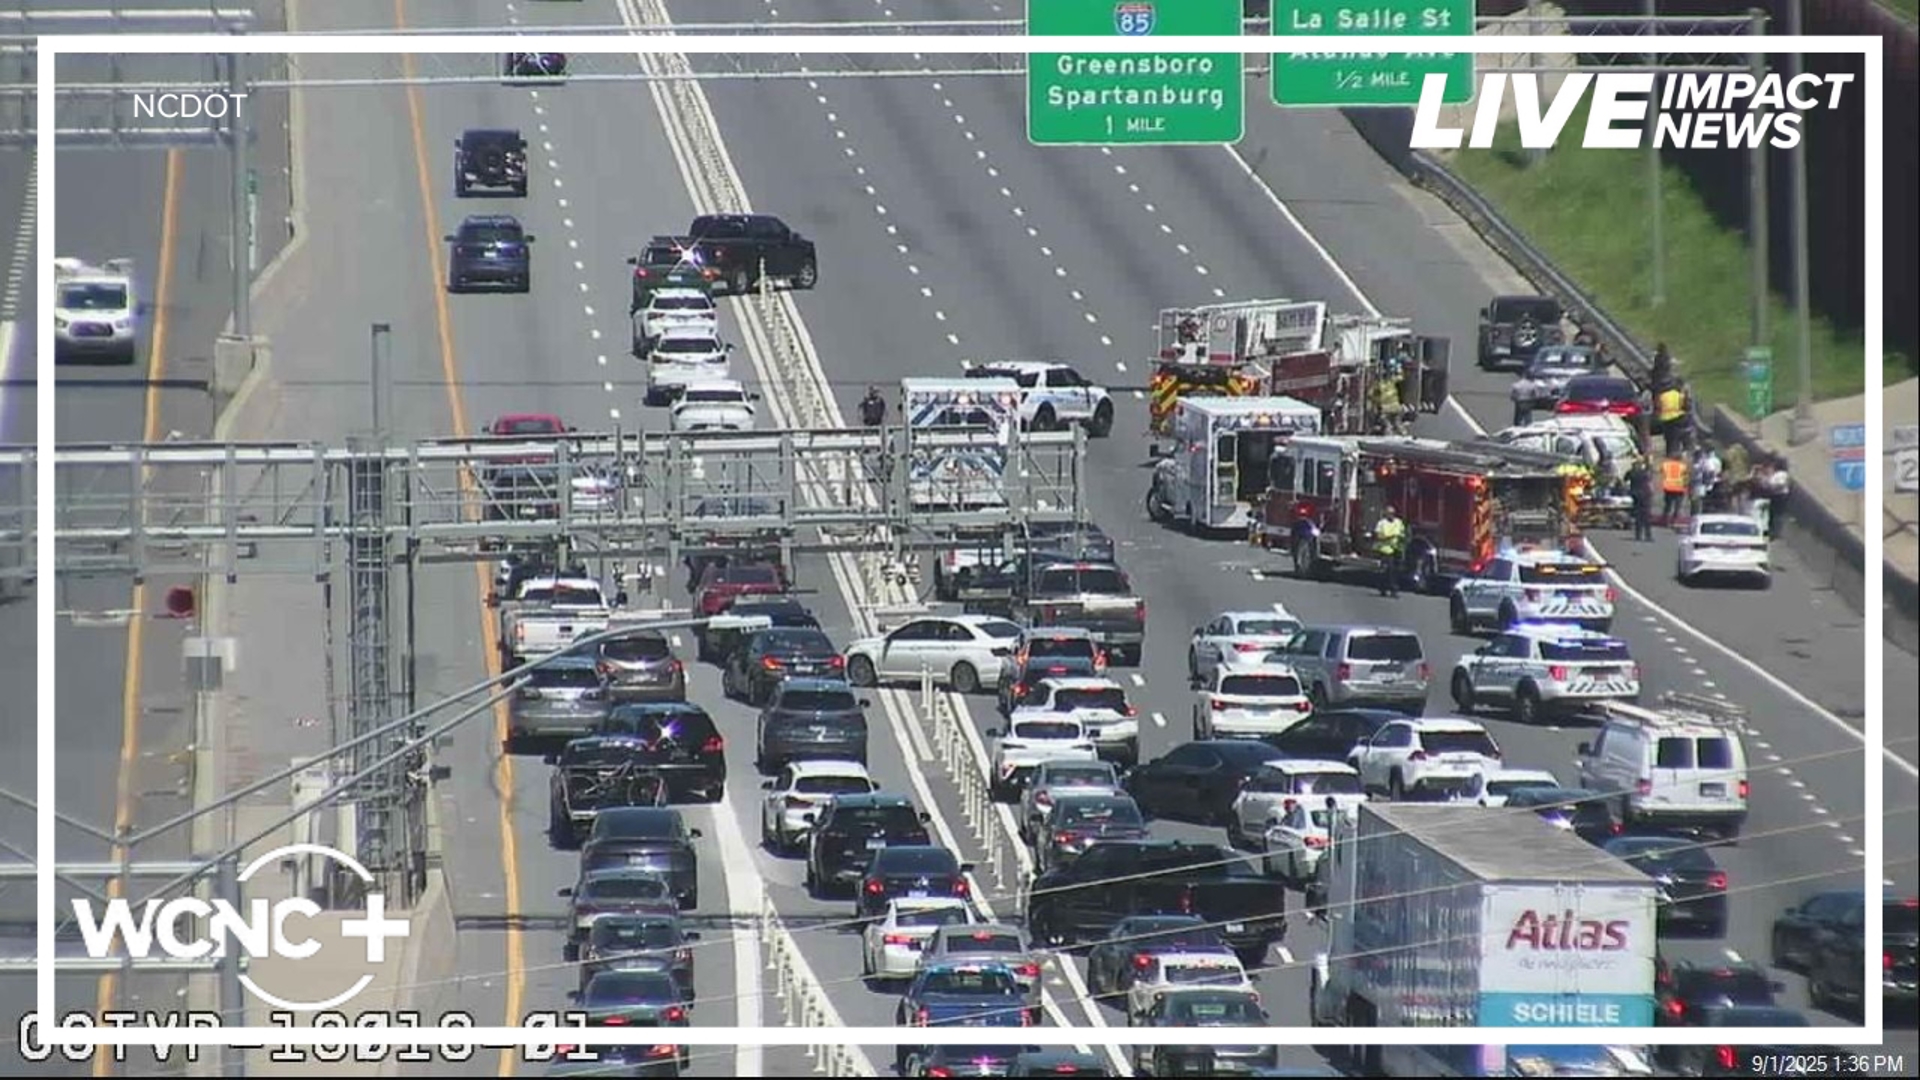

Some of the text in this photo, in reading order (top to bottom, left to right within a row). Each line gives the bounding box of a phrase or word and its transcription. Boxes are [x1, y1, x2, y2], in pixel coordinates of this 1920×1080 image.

[1119, 12, 1149, 33] 85
[1293, 8, 1452, 29] La Salle St
[1057, 55, 1213, 75] Greensboro
[1370, 71, 1411, 87] MILE
[1048, 85, 1224, 110] Spartanburg
[1105, 115, 1166, 135] 1 MILE
[1506, 908, 1631, 951] Atlas
[1513, 1003, 1621, 1023] SCHIELE
